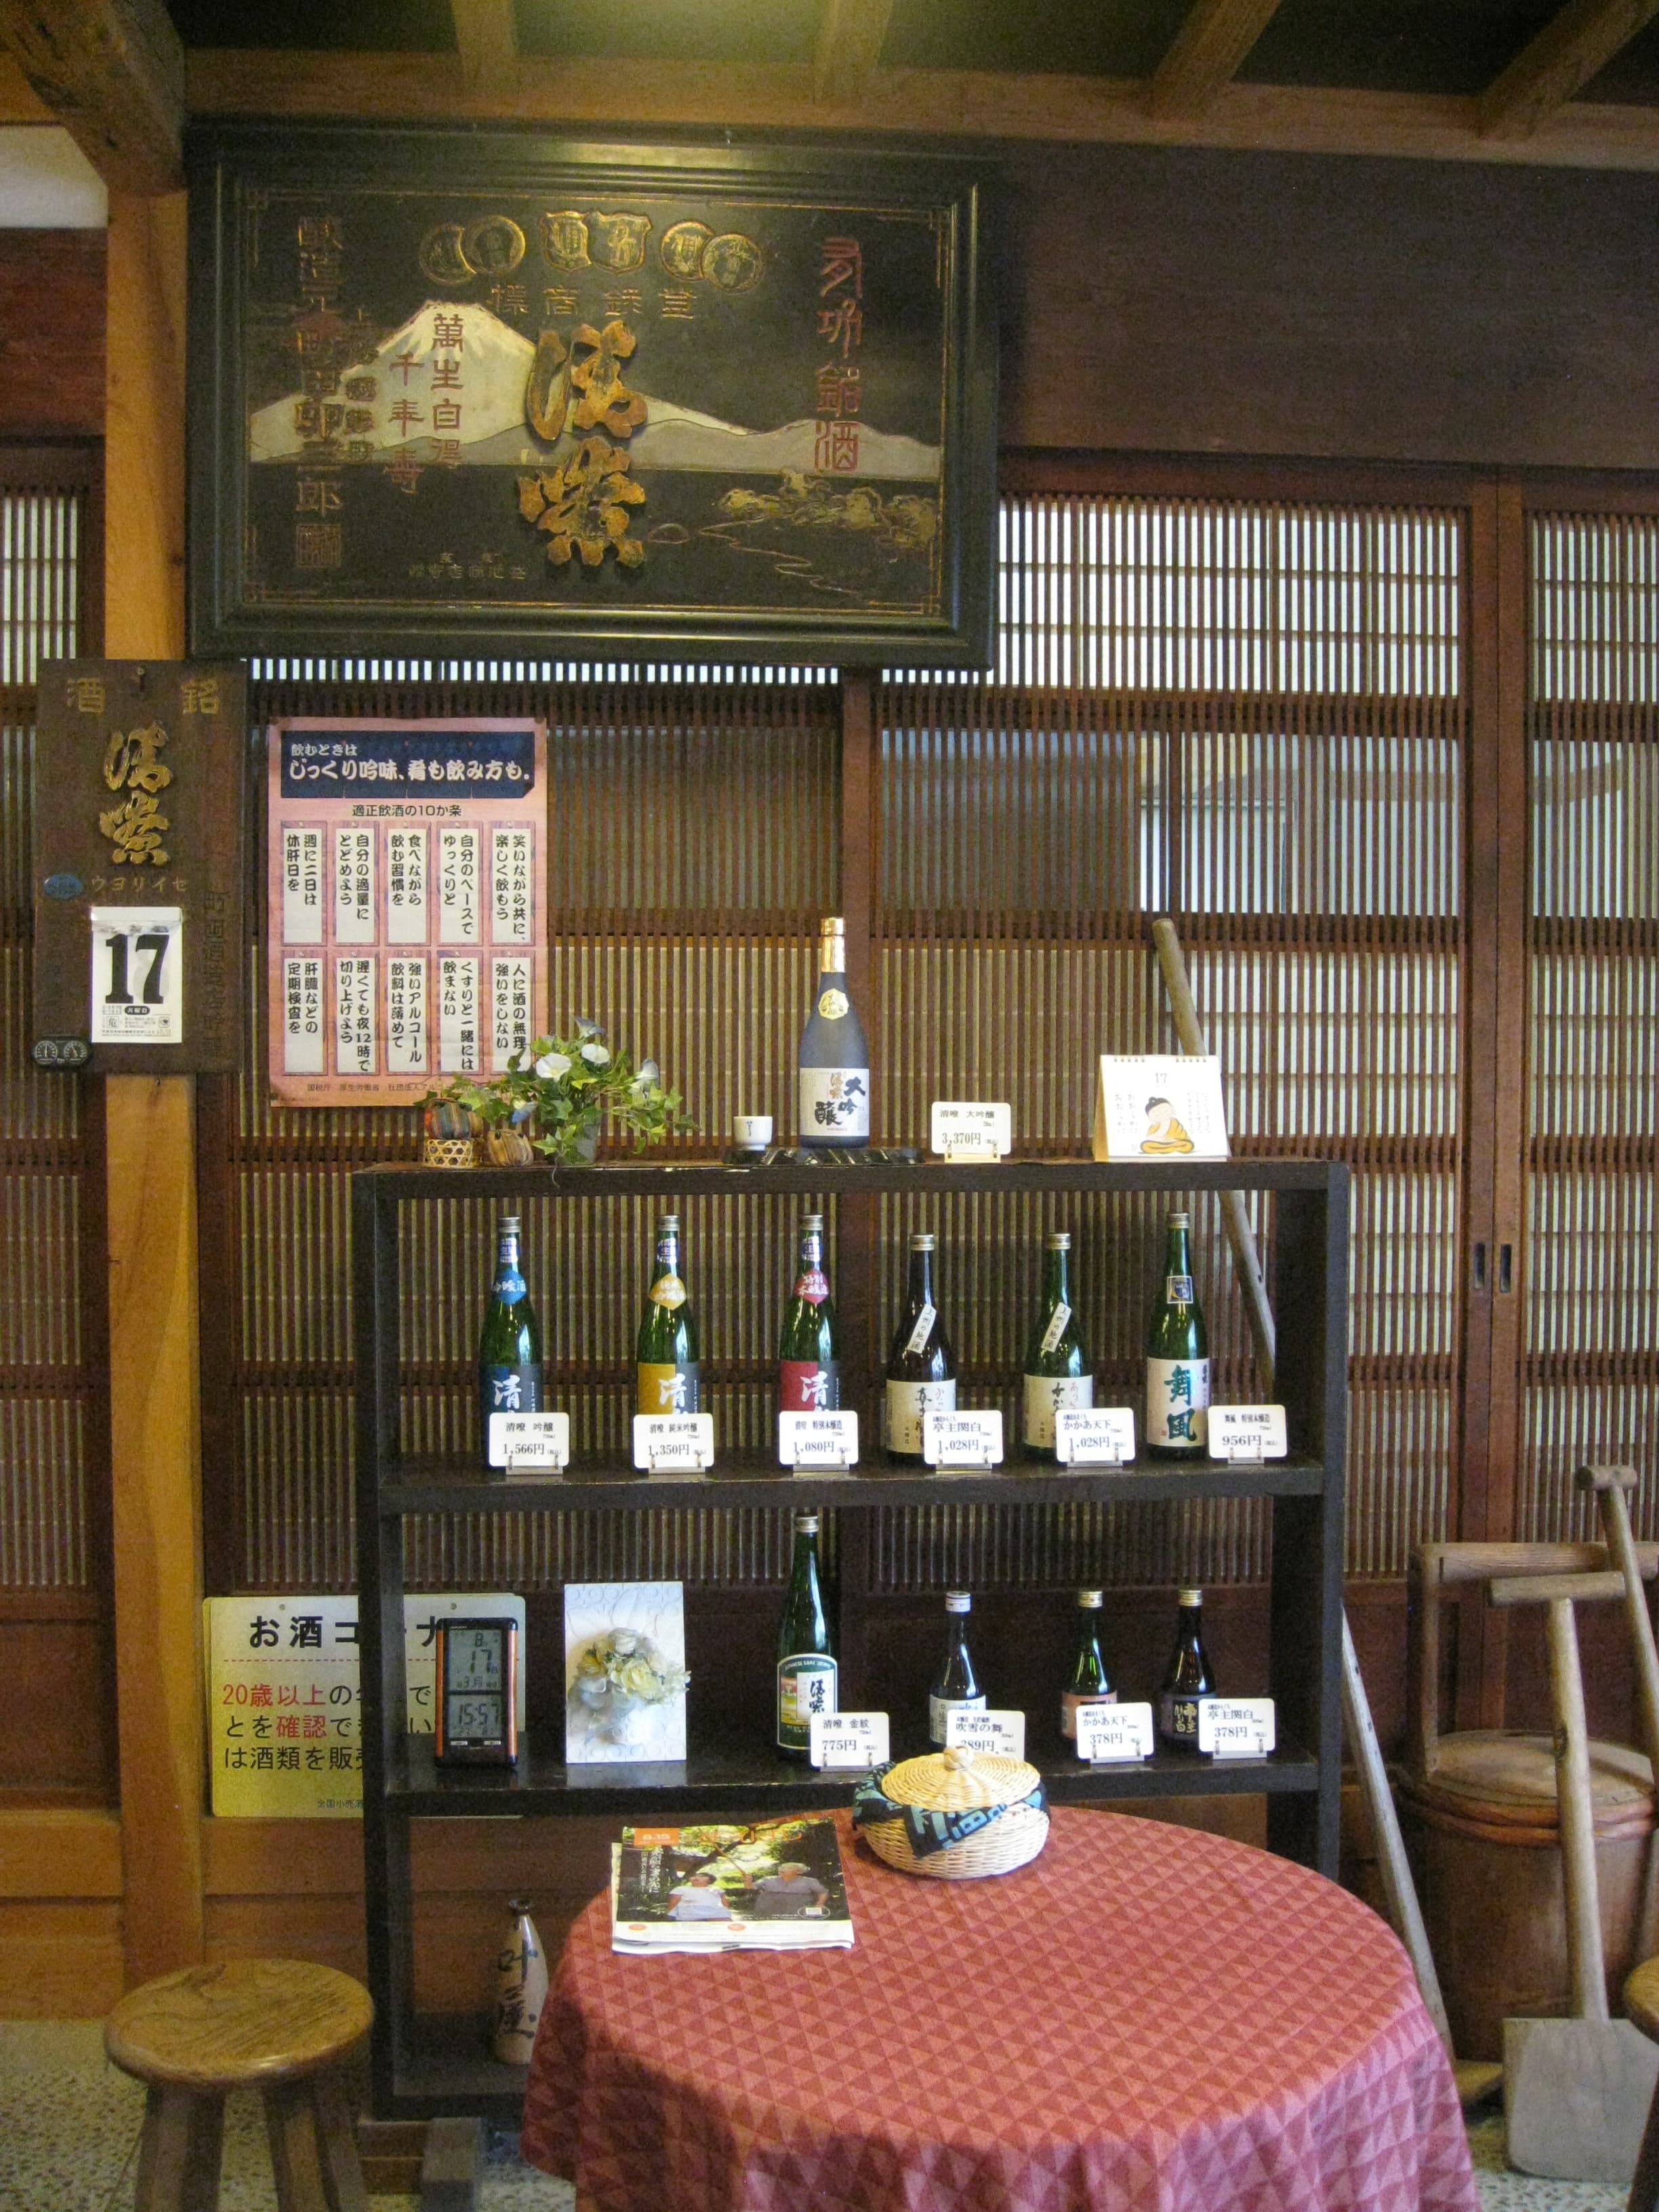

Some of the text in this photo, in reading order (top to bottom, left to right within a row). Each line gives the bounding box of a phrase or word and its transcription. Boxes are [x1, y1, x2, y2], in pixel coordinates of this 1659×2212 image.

[289, 759, 531, 781] じっくり吟味、肴も飲み方も。
[291, 744, 357, 757] 飲むときは
[352, 804, 462, 817] 適正飲酒の10か条
[287, 834, 300, 891] 休肝日を
[304, 834, 317, 906] 週に二日は
[340, 834, 352, 905] とどめよう
[356, 834, 369, 920] 自分の適量に
[391, 834, 405, 906] 飲む習慣を
[408, 834, 422, 906] 食べながら
[443, 834, 456, 905] ゆっくりと
[495, 834, 509, 920] 楽しく飲もう
[460, 834, 474, 935] 自分のペースで
[512, 834, 527, 942] 笑いながら共に、
[106, 934, 169, 1004] 17
[444, 961, 456, 1016] 飲まない
[287, 962, 302, 1033] 定期検査を
[305, 962, 319, 1033] 肝臓などの
[340, 961, 353, 1044] 切り上げよう
[356, 960, 371, 1071] 遅くても夜12時で
[391, 963, 405, 1048] 飲料は薄めて
[409, 962, 422, 1063] 強いアルコール
[461, 961, 474, 1071] くすりと一緒には
[496, 963, 510, 1049] 強いをしない
[513, 963, 527, 1050] 人に酒の無理
[1155, 1072, 1168, 1084] 17
[942, 1132, 981, 1145] 3,370円
[492, 1374, 522, 1412] 清
[658, 1372, 687, 1414] 清
[800, 1370, 829, 1411] 清
[933, 1422, 981, 1433] 亭主関白
[938, 1439, 979, 1451] 1,028円
[1063, 1419, 1111, 1430] かかあ天下
[1069, 1436, 1109, 1448] 1,028円
[1222, 1435, 1261, 1446] 956円
[504, 1443, 544, 1455] 1,566円
[648, 1444, 690, 1456] 1,350円
[794, 1441, 834, 1452] 1,080円
[956, 1723, 1003, 1733] 吹雪の舞
[1083, 1715, 1128, 1727] かかあ天下
[1208, 1708, 1252, 1720] 亭主関白
[1214, 1726, 1248, 1738] 378円
[821, 1739, 857, 1750] 775円
[1090, 1732, 1123, 1744] 378円
